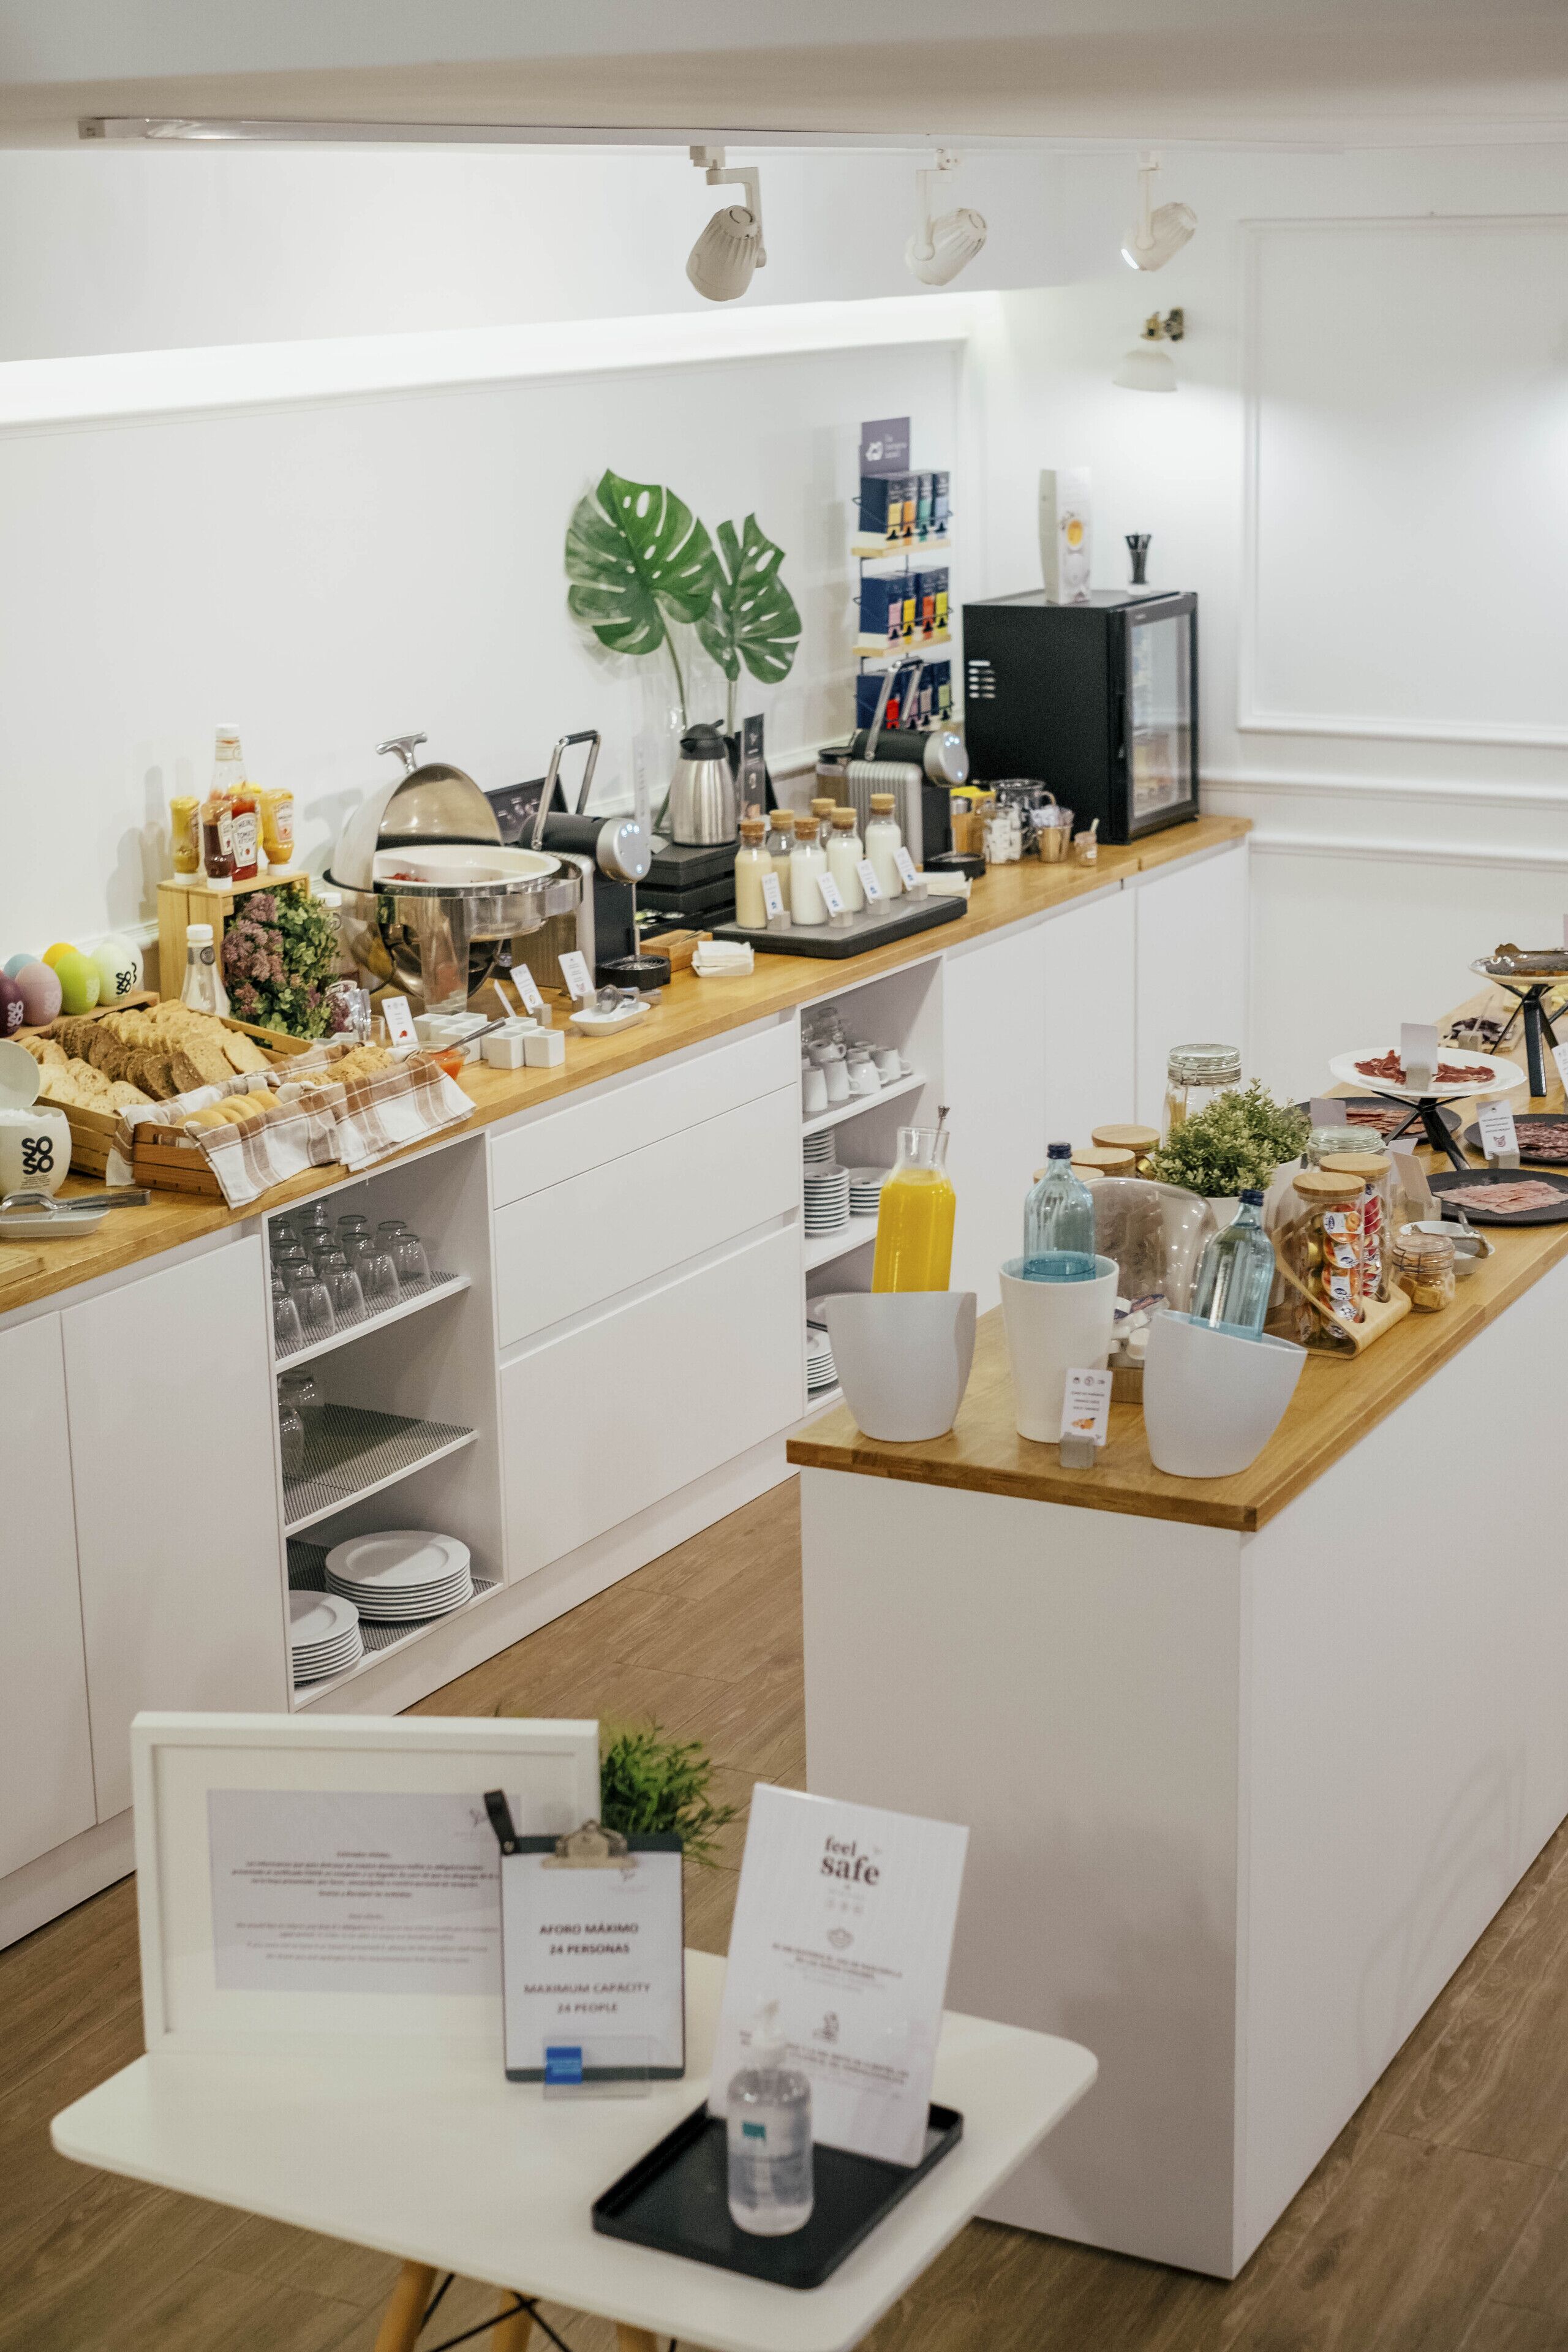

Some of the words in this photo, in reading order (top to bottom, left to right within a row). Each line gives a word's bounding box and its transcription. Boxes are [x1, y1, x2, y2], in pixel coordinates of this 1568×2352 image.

[21, 1136, 53, 1157] SO
[22, 1155, 54, 1175] SO
[825, 1836, 857, 1857] feel
[820, 1855, 880, 1886] safe
[539, 1924, 581, 1935] AFORO
[584, 1921, 639, 1934] MÁXIMO
[549, 1944, 564, 1955] 24
[567, 1943, 630, 1954] PERSONAS
[524, 1983, 590, 1994] MAXIMUM
[593, 1982, 650, 1993] CAPACITY
[557, 2003, 571, 2014] 24
[574, 2002, 618, 2013] PEOPLE
